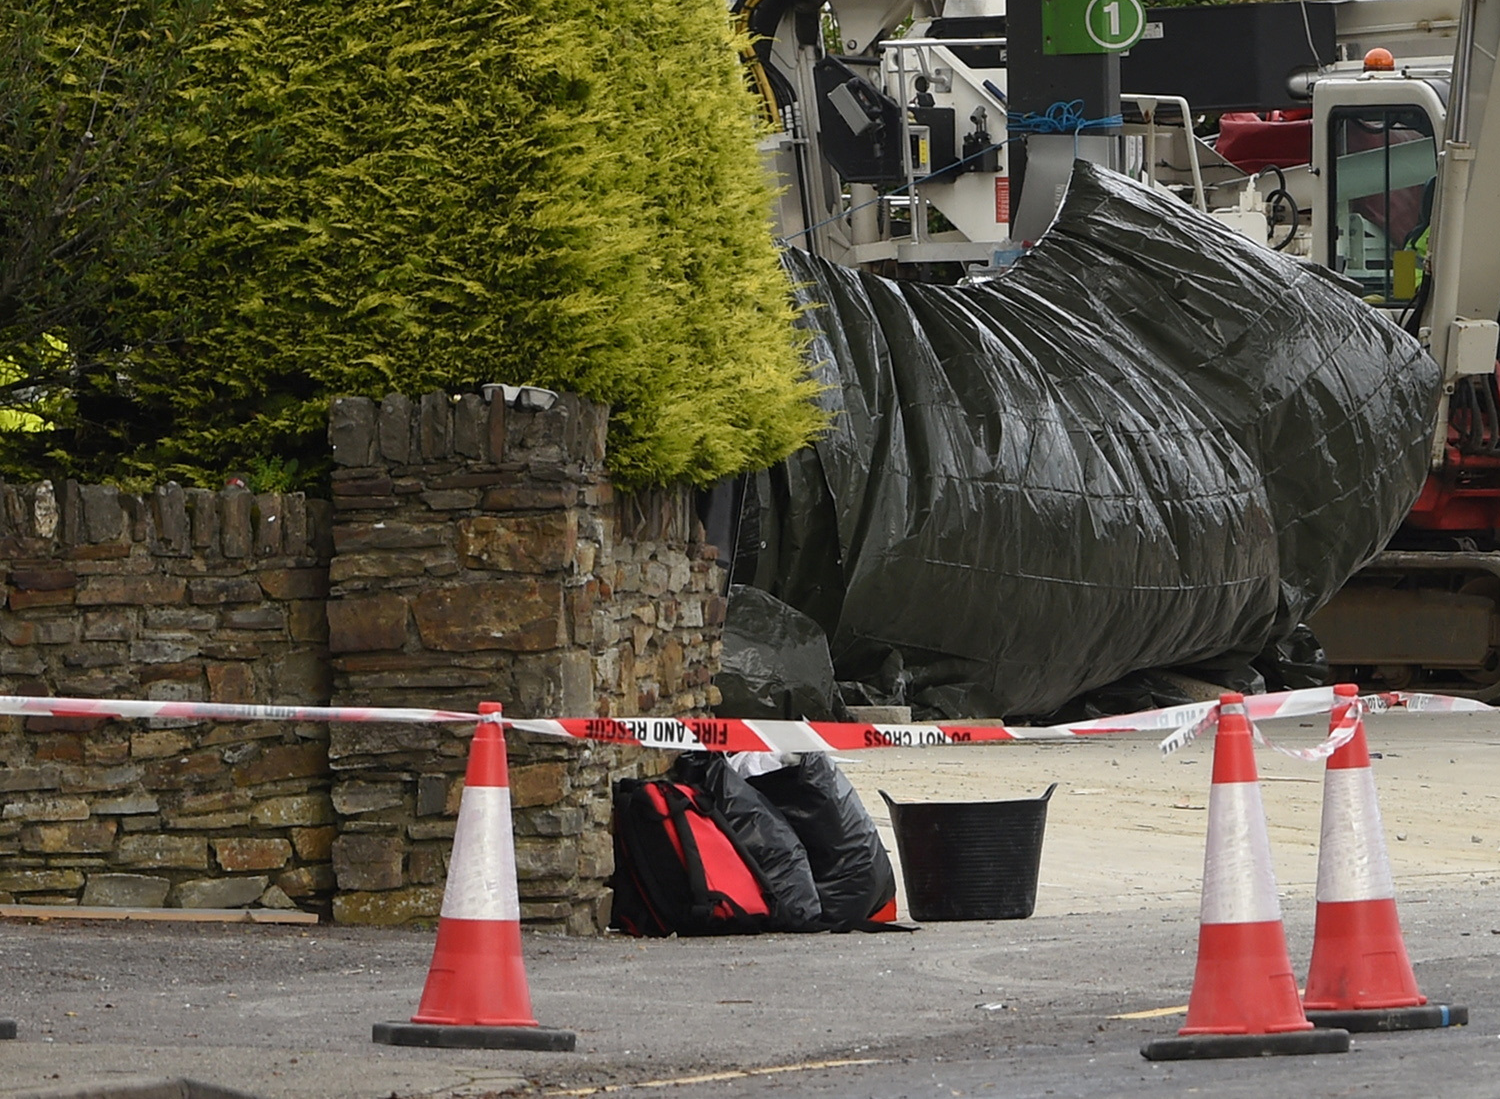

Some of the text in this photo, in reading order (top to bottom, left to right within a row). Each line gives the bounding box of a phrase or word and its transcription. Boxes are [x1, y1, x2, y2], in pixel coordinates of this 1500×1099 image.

[1103, 1, 1120, 35] 1
[585, 720, 728, 745] FIRE AND RESCUE
[863, 730, 912, 747] CROSS
